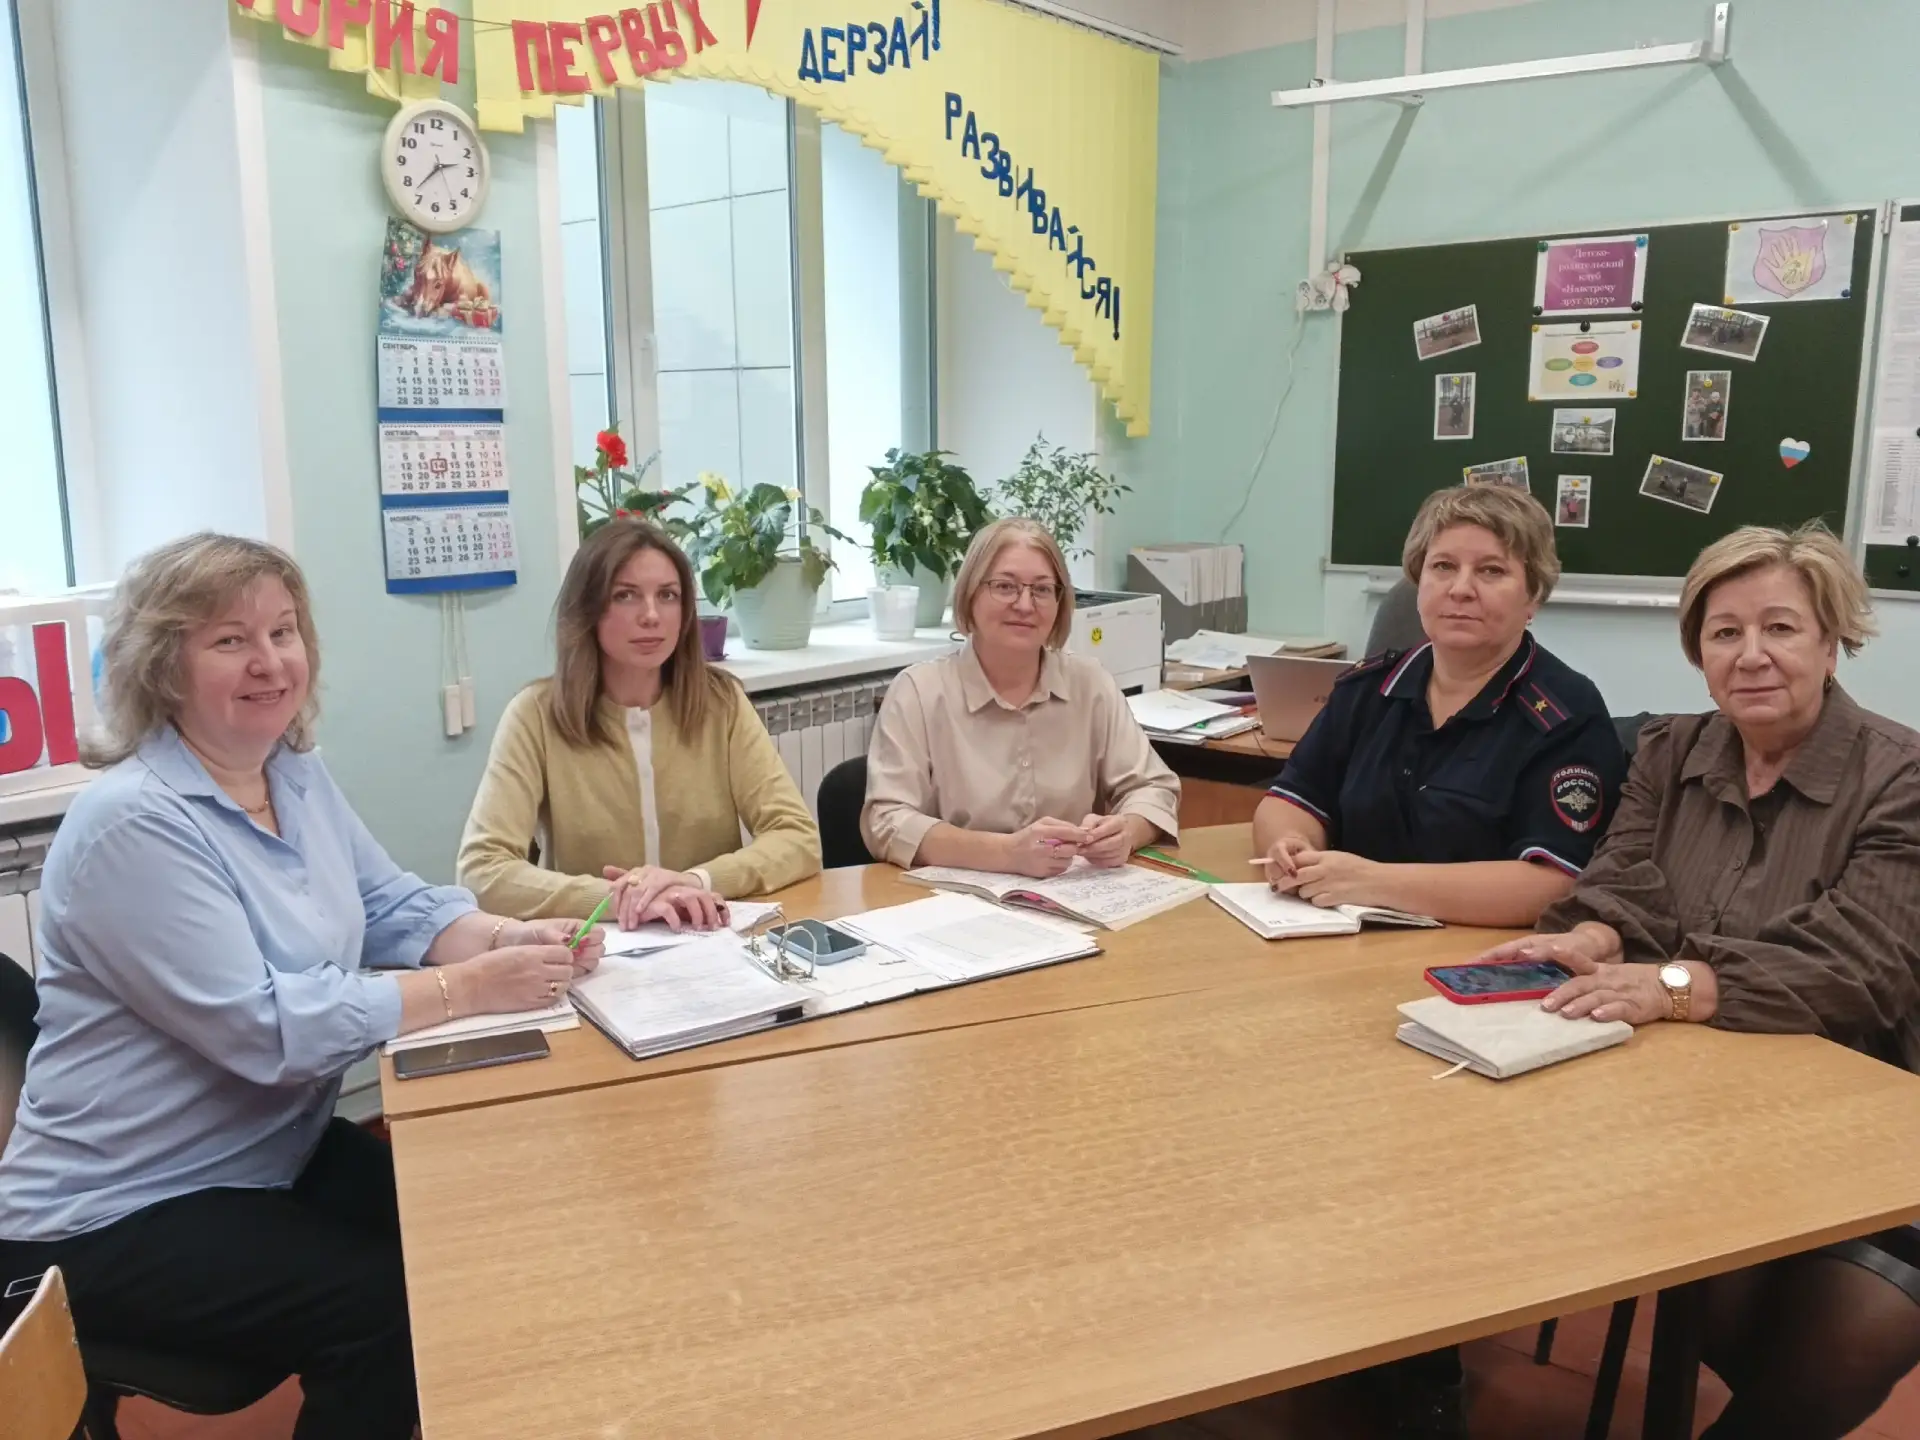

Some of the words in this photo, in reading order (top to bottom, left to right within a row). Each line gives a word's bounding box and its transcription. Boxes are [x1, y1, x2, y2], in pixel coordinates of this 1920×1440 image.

[512, 0, 718, 93] ПЕРВЫХ
[798, 0, 941, 83] ДЕРЗАЙ!
[414, 123, 425, 134] 11
[430, 119, 443, 130] 12
[453, 131, 458, 140] 1
[400, 137, 417, 149] 10
[463, 148, 471, 159] 2
[397, 155, 406, 166] 9
[466, 167, 474, 177] 3
[403, 176, 412, 186] 8
[460, 188, 468, 198] 4
[415, 194, 422, 205] 7
[431, 202, 439, 212] 6
[449, 200, 457, 210] 5
[945, 92, 1120, 341] РАЗВИВАЙСЯ!
[1574, 249, 1610, 259] Детско-
[1559, 260, 1623, 272] родительский
[1579, 272, 1601, 281] клуб
[443, 358, 448, 366] 3
[398, 366, 403, 374] 7
[428, 367, 434, 375] 9
[457, 368, 466, 376] 11
[489, 369, 499, 377] 13
[398, 397, 408, 405] 28
[413, 397, 423, 405] 29
[419, 452, 425, 460] 6
[401, 462, 412, 470] 12
[402, 472, 412, 480] 19
[451, 471, 460, 479] 22
[441, 545, 452, 553] 18
[409, 567, 420, 575] 30
[1554, 768, 1600, 782] ПОЛИЦИЯ
